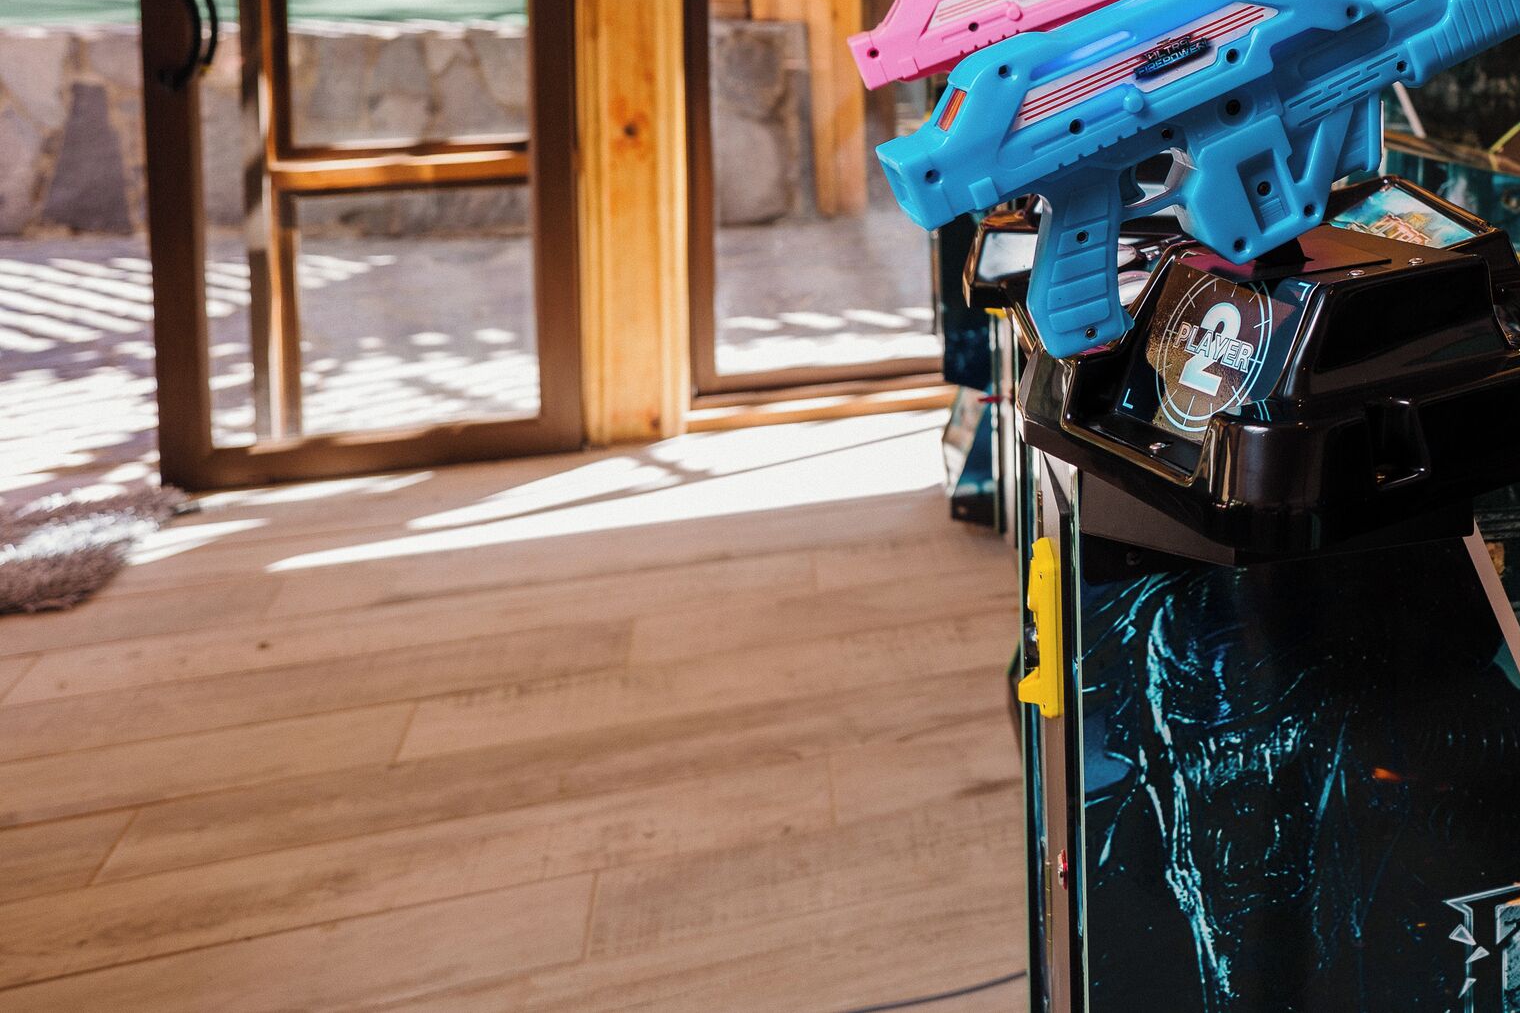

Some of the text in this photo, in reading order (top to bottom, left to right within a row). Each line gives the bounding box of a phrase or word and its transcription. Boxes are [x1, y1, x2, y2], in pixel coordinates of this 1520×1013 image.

[1147, 39, 1190, 61] ULTRA
[1173, 321, 1255, 374] PLAYER
[1178, 301, 1242, 397] 2
